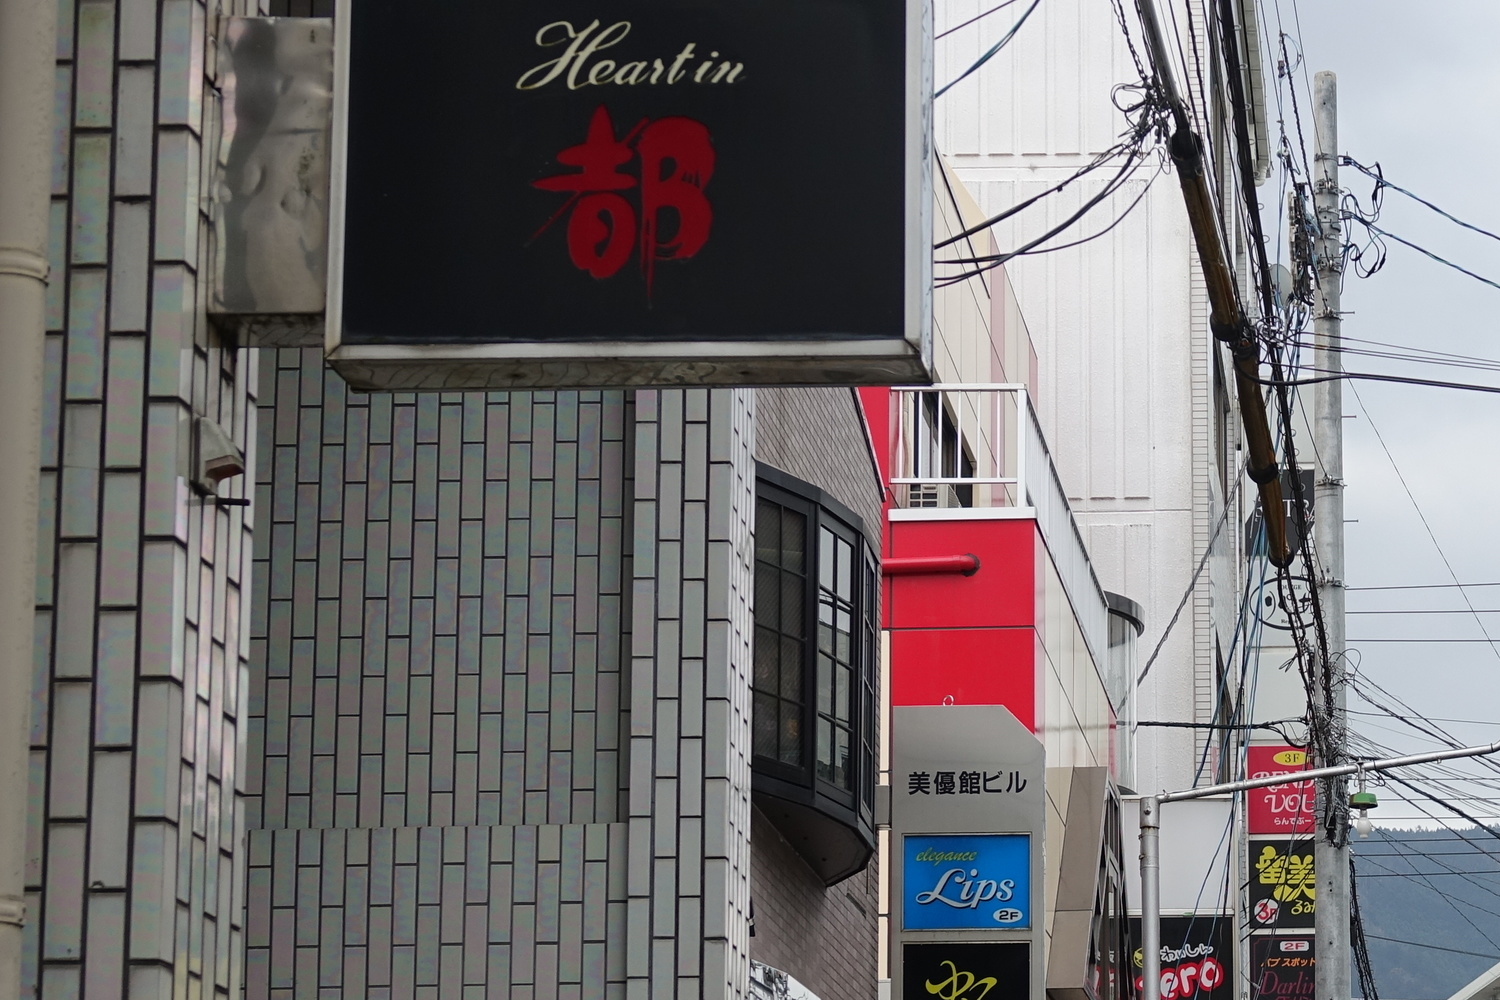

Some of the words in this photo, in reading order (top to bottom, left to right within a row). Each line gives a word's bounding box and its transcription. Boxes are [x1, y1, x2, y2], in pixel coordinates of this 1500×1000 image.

[516, 19, 696, 90] Heart
[524, 102, 716, 304] 都
[1284, 753, 1300, 763] 3F
[908, 770, 1028, 796] 美優館ビル
[1252, 770, 1316, 793] REND
[915, 847, 978, 866] elegance
[915, 868, 1016, 910] Lips
[998, 909, 1019, 921] 2F
[1257, 902, 1278, 921] 3F
[1283, 942, 1306, 951] 2F
[1139, 961, 1221, 999] ero
